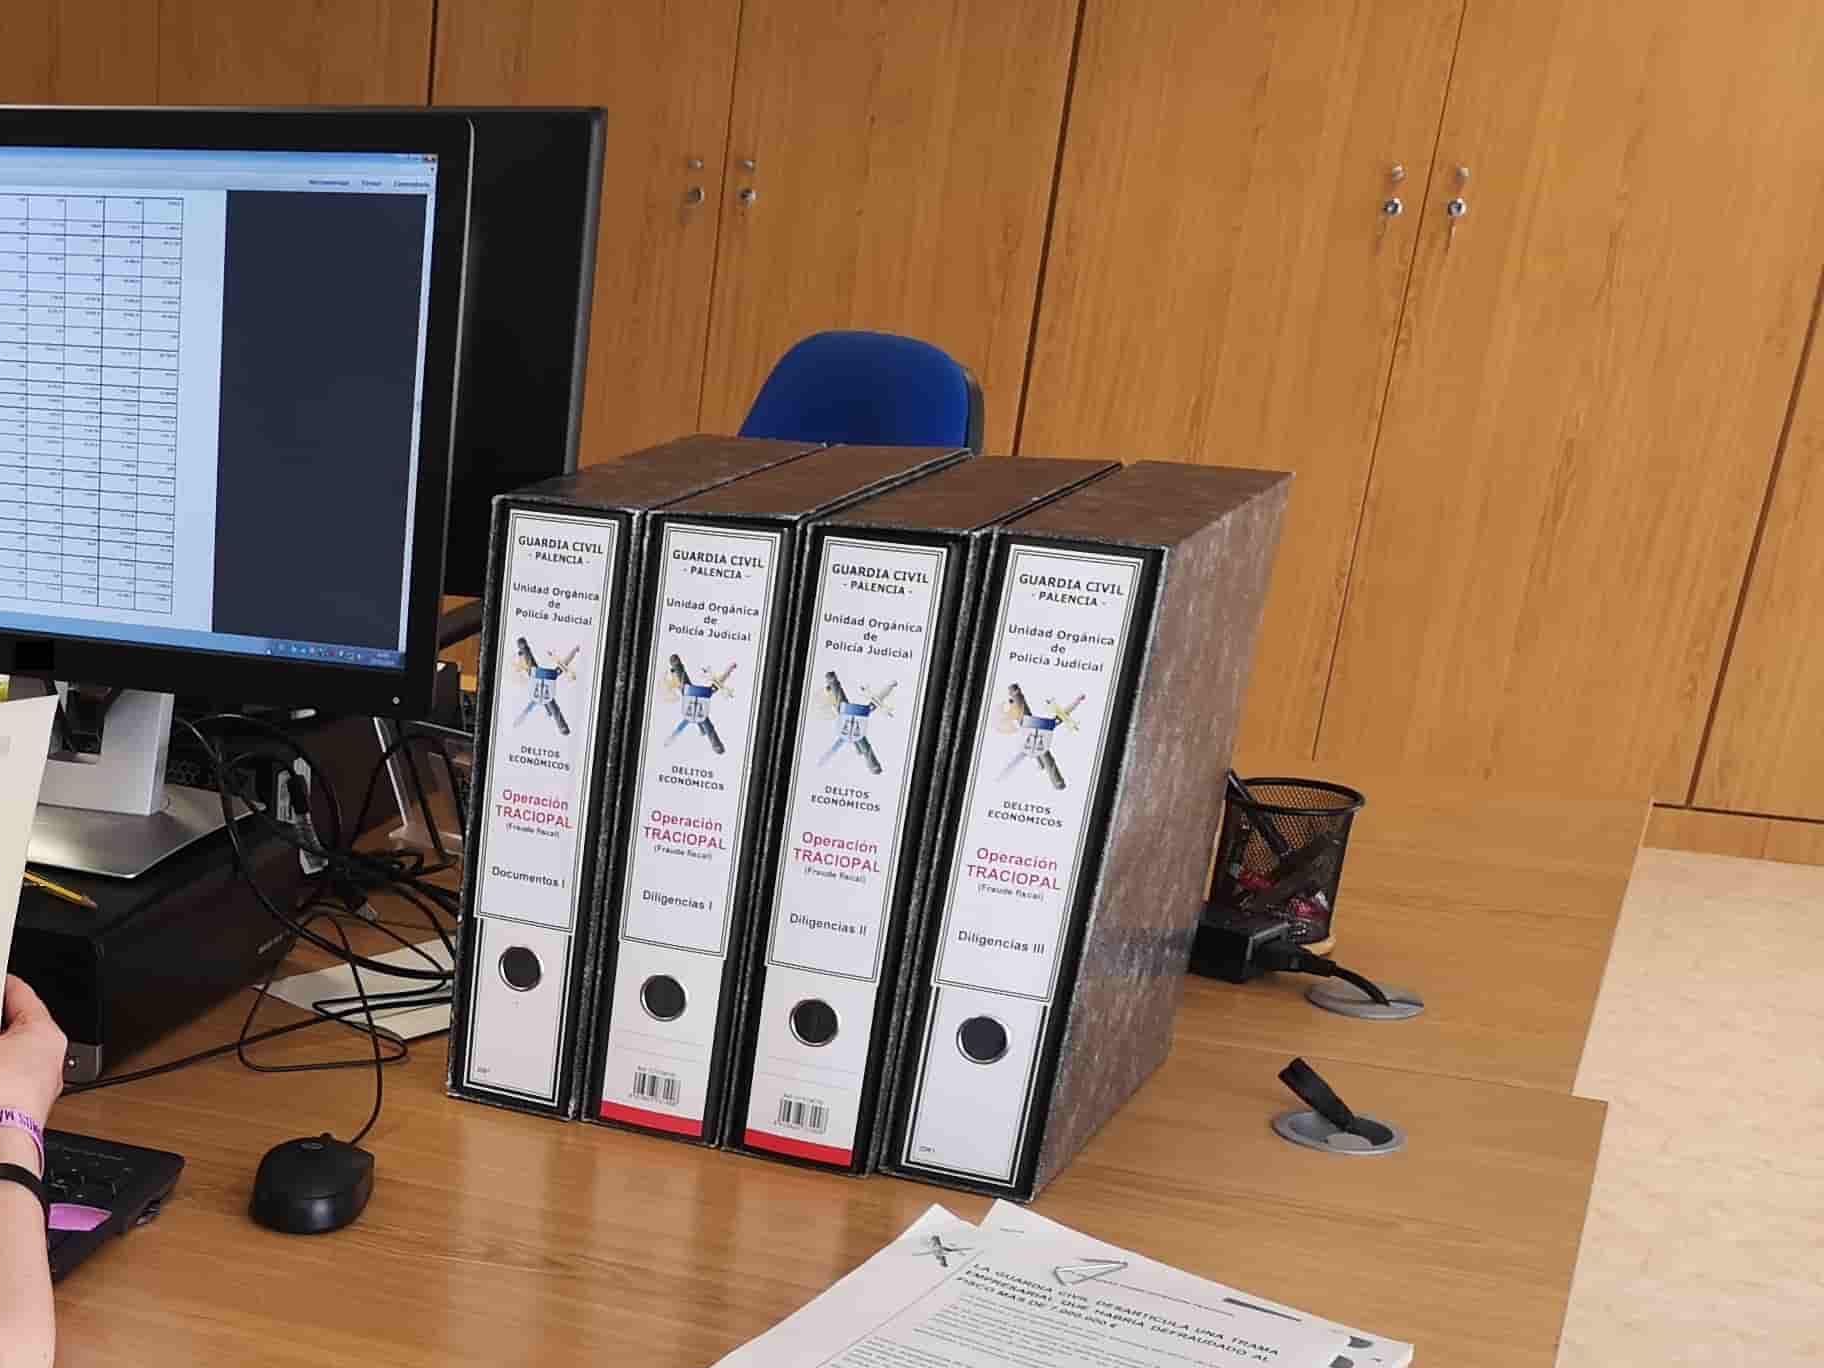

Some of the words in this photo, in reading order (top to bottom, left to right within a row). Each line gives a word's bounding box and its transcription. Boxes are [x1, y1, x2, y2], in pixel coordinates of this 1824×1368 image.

[518, 535, 569, 551] GUARDIA
[573, 542, 604, 554] CIVIL
[536, 551, 583, 565] PALENCIA
[673, 549, 727, 564] GUARDIA
[730, 555, 765, 568] CIVIL
[690, 566, 742, 579] PALENCIA
[832, 563, 889, 579] GUARDIA
[894, 570, 929, 584] CIVIL
[513, 582, 549, 594] Unidad
[850, 580, 905, 594] PALENCIA
[1019, 573, 1081, 590] GUARDIA
[1086, 582, 1124, 596] CIVIL
[548, 600, 561, 608] de
[666, 597, 705, 610] Unidad
[1038, 591, 1098, 606] PALENCIA
[552, 612, 592, 625] Judicial
[703, 616, 718, 625] de
[824, 613, 865, 626] Unidad
[708, 628, 751, 641] Judicial
[863, 632, 878, 641] de
[1008, 624, 1053, 639] Unidad
[867, 645, 913, 659] Judicial
[1050, 643, 1066, 654] de
[1054, 658, 1103, 672] Judicial
[521, 745, 560, 758] DELITOS
[672, 765, 714, 778] DELITOS
[825, 785, 870, 799] DELITOS
[502, 789, 568, 811] Operación
[1003, 801, 1052, 815] DELITOS
[496, 804, 574, 829] TRACIOPAL
[651, 810, 722, 832] Operación
[643, 826, 726, 850] TRACIOPAL
[802, 831, 878, 854] Operación
[793, 848, 880, 873] TRACIOPAL
[976, 847, 1057, 871] Operación
[492, 866, 559, 887] Documentos
[967, 864, 1061, 890] TRACIOPAL
[643, 890, 705, 910] Diligencias
[790, 913, 856, 934] Diligencias
[958, 931, 1028, 952] Diligencias
[995, 1271, 1052, 1292] GUARDIA
[1232, 1337, 1278, 1356] TRAMA
